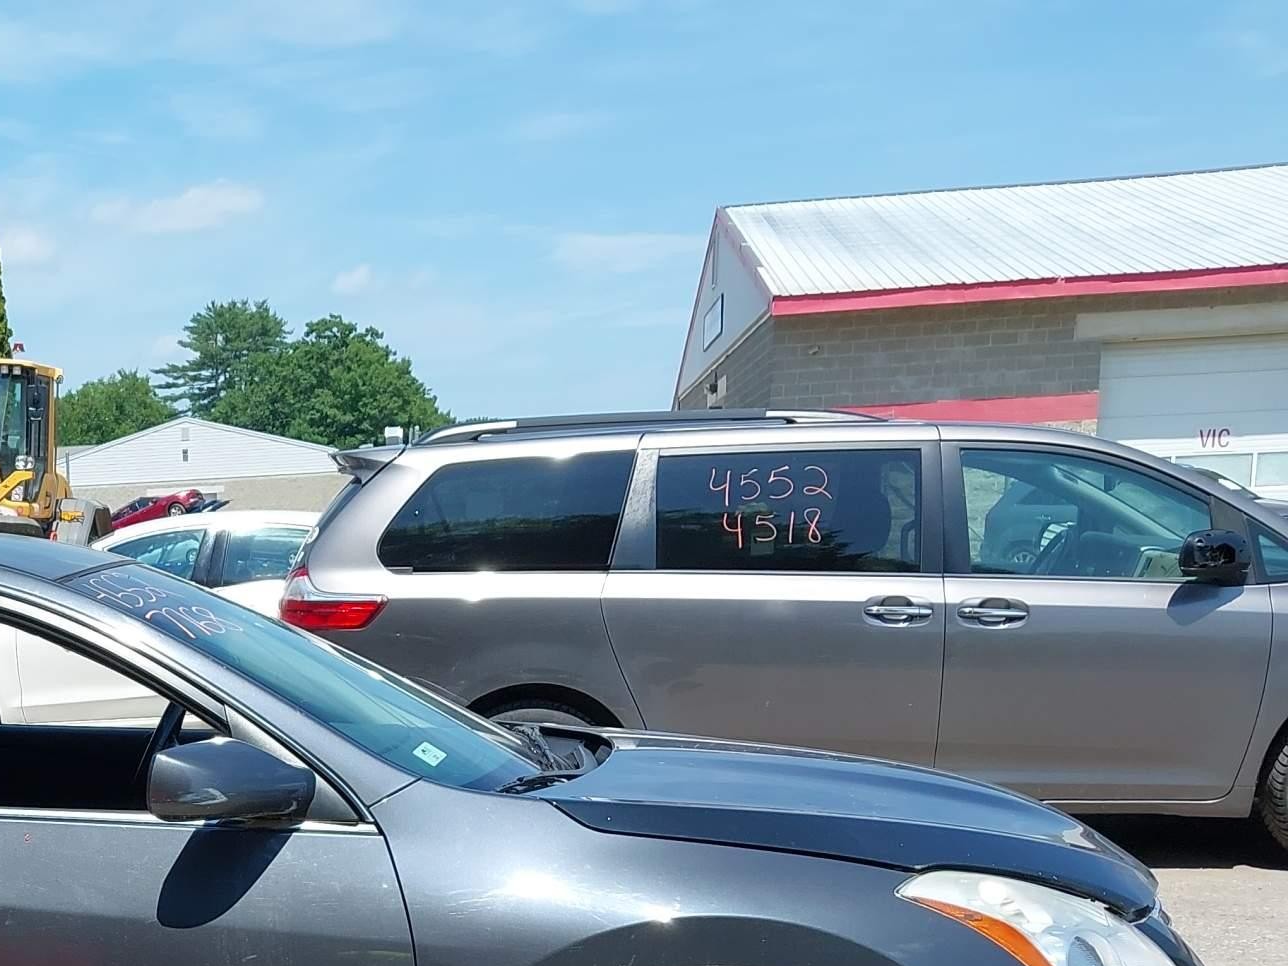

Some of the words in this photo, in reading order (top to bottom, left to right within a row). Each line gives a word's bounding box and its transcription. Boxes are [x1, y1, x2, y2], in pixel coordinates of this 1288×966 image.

[1199, 428, 1231, 448] VIC
[709, 464, 833, 507] 4552
[723, 507, 823, 549] 4518
